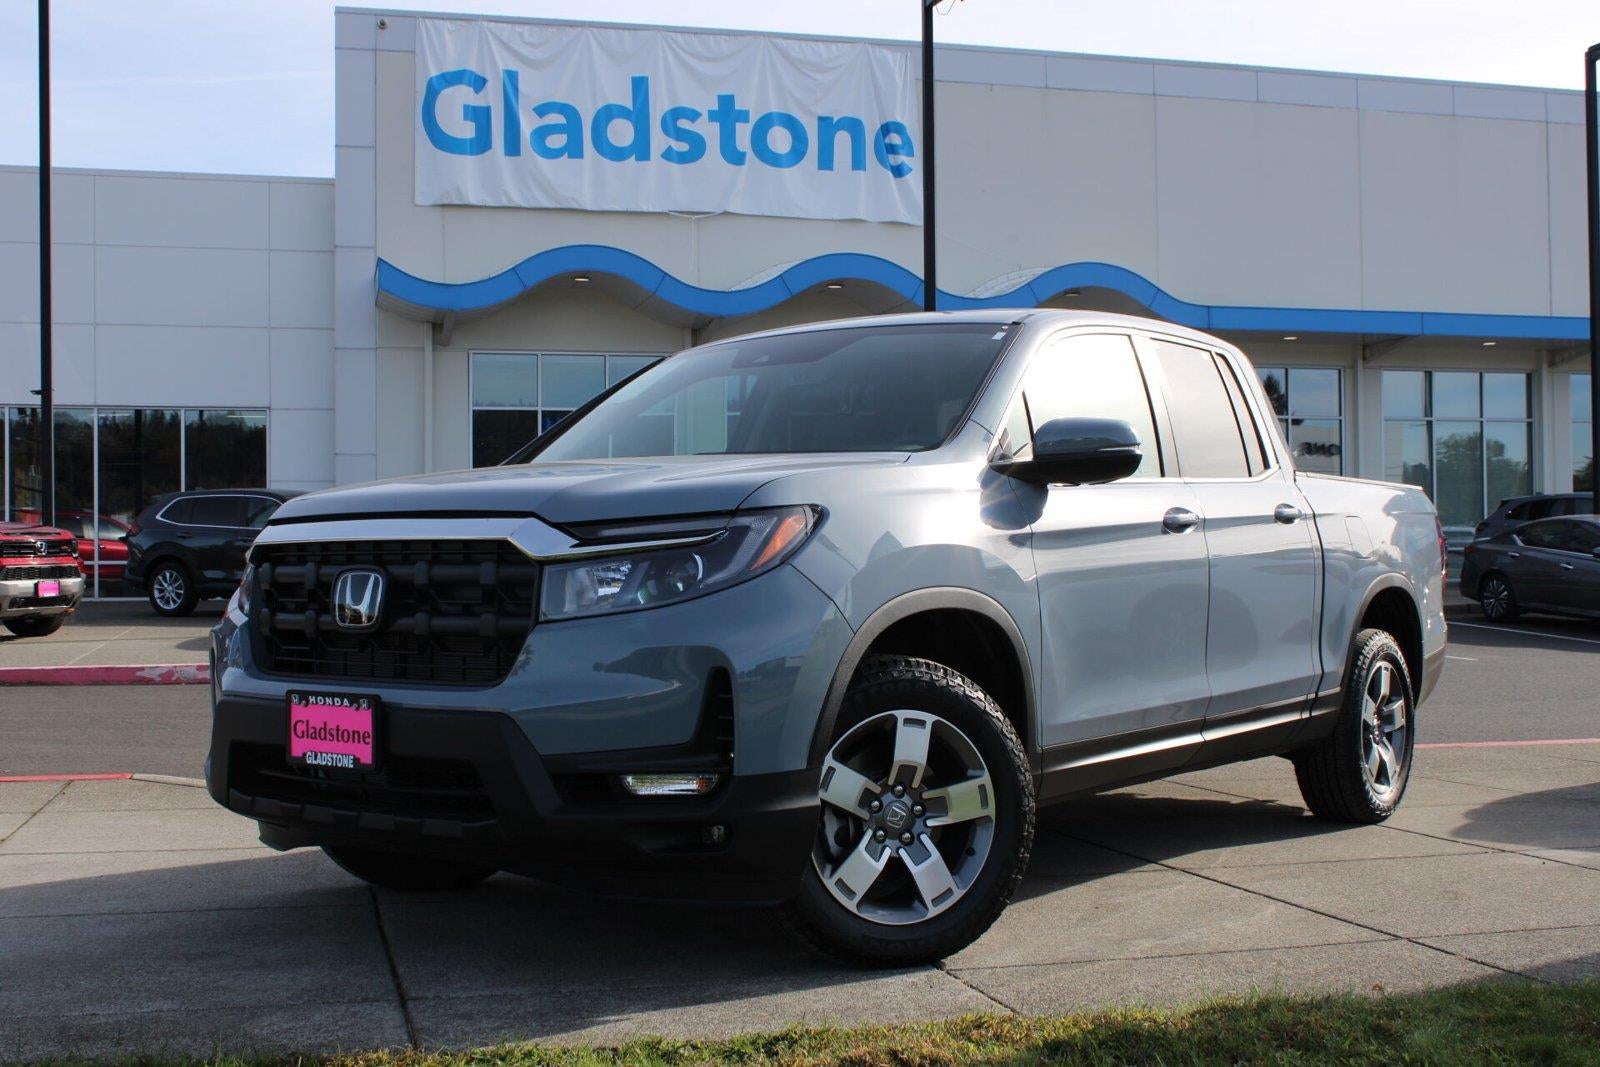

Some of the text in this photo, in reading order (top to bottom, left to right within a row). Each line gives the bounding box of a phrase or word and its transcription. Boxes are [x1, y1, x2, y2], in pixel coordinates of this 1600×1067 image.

[421, 67, 916, 179] Gladstone
[308, 695, 350, 707] HONDA
[293, 719, 371, 745] Gladstone
[306, 751, 354, 768] GLADSTONE
